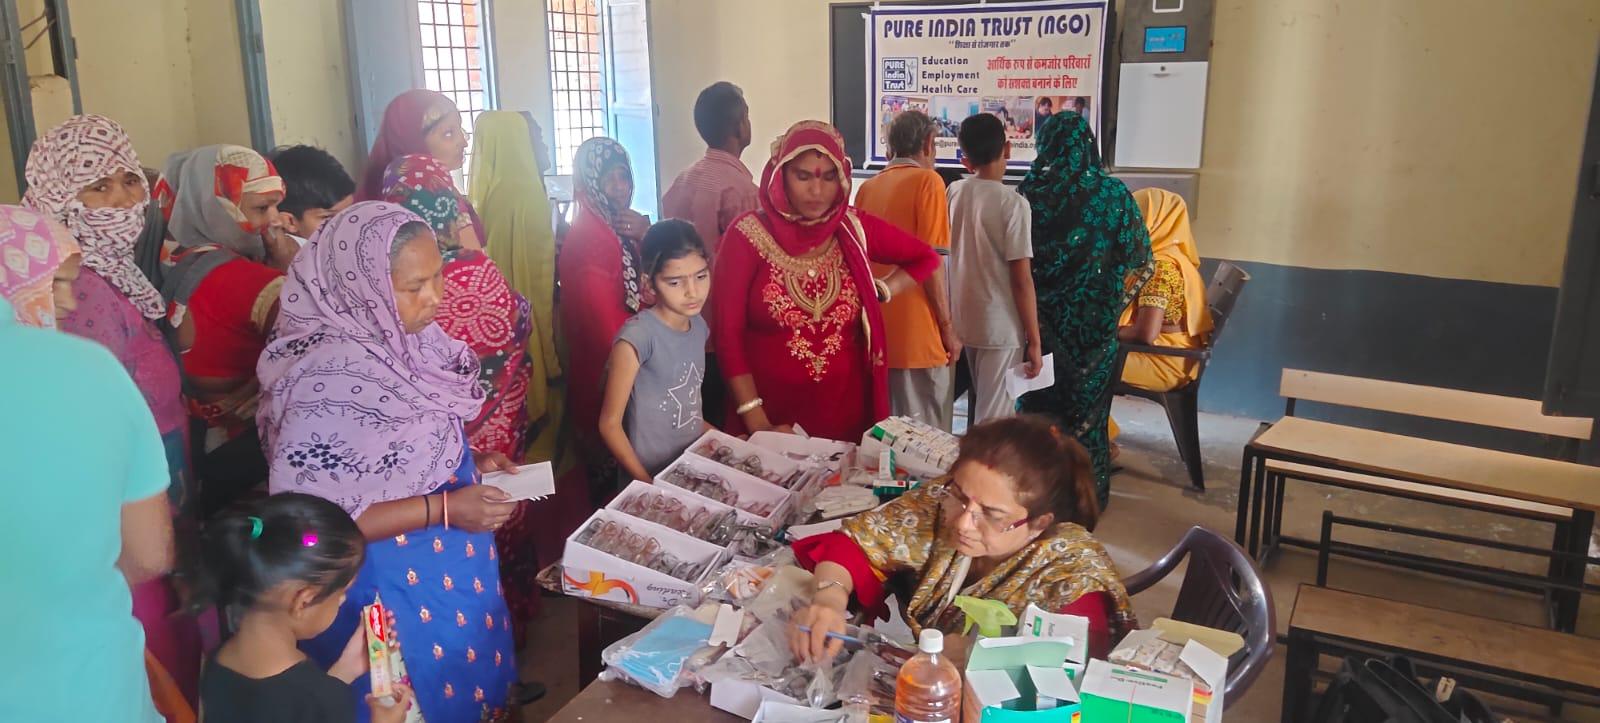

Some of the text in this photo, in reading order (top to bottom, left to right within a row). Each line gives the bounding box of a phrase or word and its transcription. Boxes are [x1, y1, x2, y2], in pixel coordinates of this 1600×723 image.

[884, 20, 923, 38] PURE
[929, 18, 975, 37] INDIA
[981, 17, 1032, 36] TRUST
[885, 61, 904, 69] PURE
[922, 56, 968, 65] Education
[987, 56, 1011, 70] आर्थिक
[1026, 57, 1033, 69] से
[1034, 56, 1061, 69] कमजोर
[922, 70, 980, 81] Employment
[885, 81, 904, 89] Trust
[997, 77, 1007, 89] को
[1032, 75, 1052, 88] बनाने
[1053, 75, 1061, 88] के
[1062, 74, 1078, 88] लिए
[922, 84, 978, 93] Health Care
